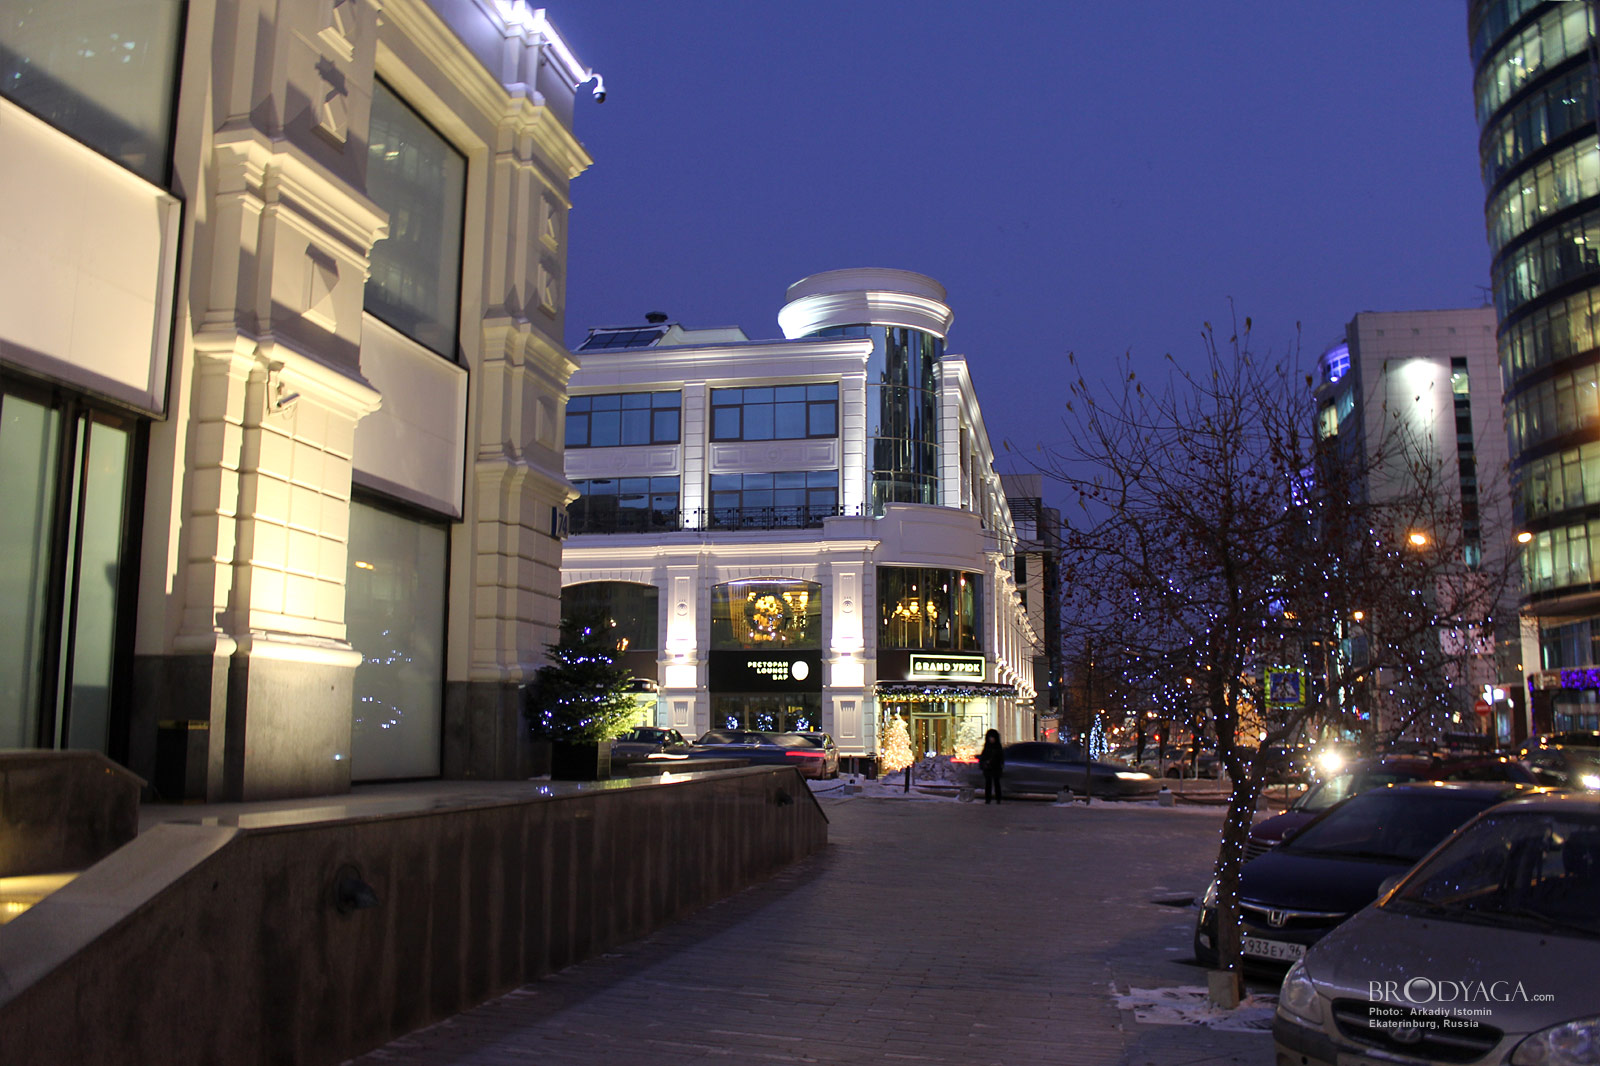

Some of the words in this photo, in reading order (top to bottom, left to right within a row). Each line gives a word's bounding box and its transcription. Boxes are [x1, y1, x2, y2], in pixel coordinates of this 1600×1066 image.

[558, 513, 567, 535] 74
[914, 661, 951, 672] GRAND
[951, 662, 980, 672] УРЮК
